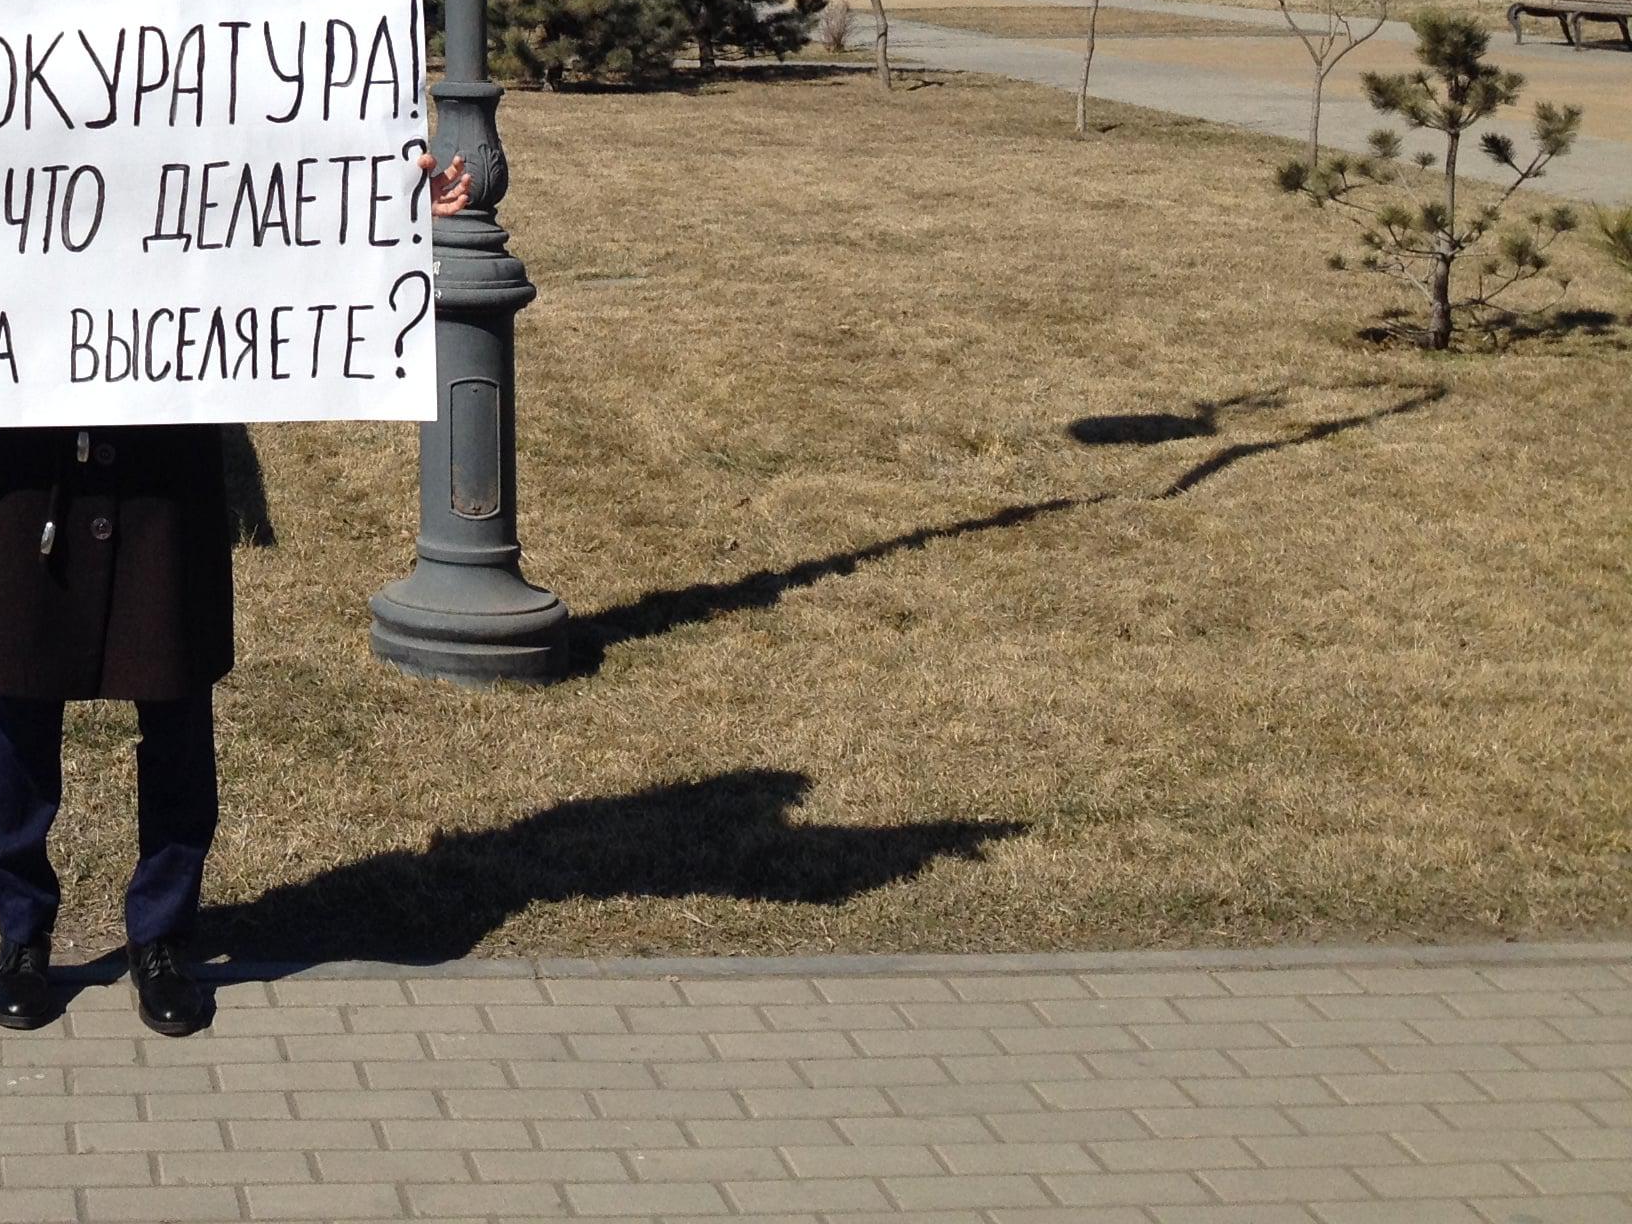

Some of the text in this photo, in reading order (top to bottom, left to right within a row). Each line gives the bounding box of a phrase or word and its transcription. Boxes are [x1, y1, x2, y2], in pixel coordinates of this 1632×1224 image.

[4, 164, 106, 255] ЧТО
[142, 138, 428, 253] ДЕЛАЕТЕ?
[70, 270, 431, 383] ВЫСЕЛЯЕТЕ?
